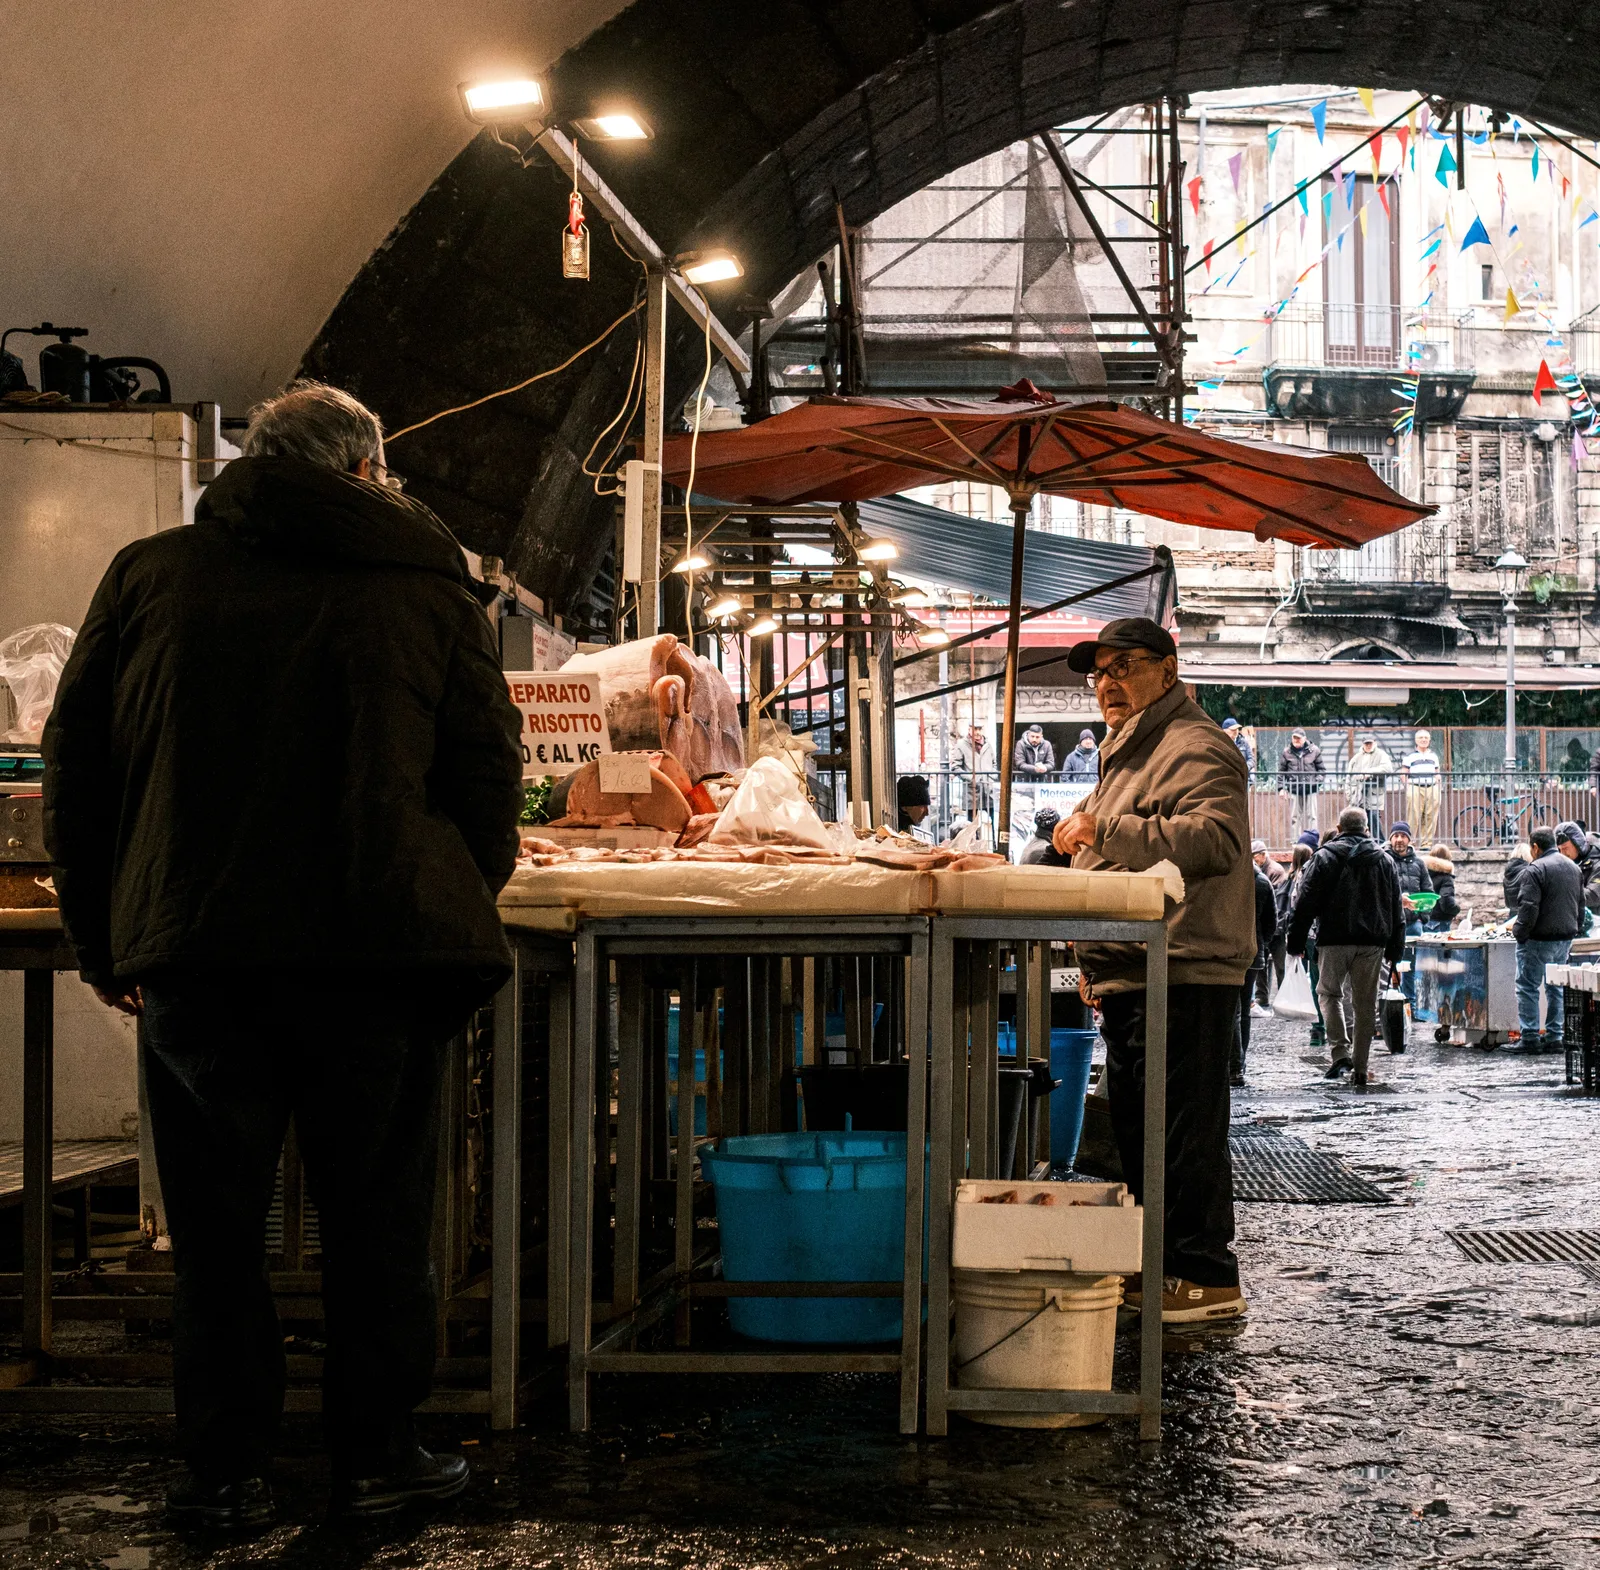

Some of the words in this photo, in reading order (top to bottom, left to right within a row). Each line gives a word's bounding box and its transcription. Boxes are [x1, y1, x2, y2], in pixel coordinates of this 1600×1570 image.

[507, 683, 591, 704] REPARATO
[528, 713, 602, 733] RISOTTO
[536, 744, 548, 763] €
[552, 743, 574, 763] AL
[577, 743, 601, 762] KG
[1040, 788, 1093, 798] Motopesc
